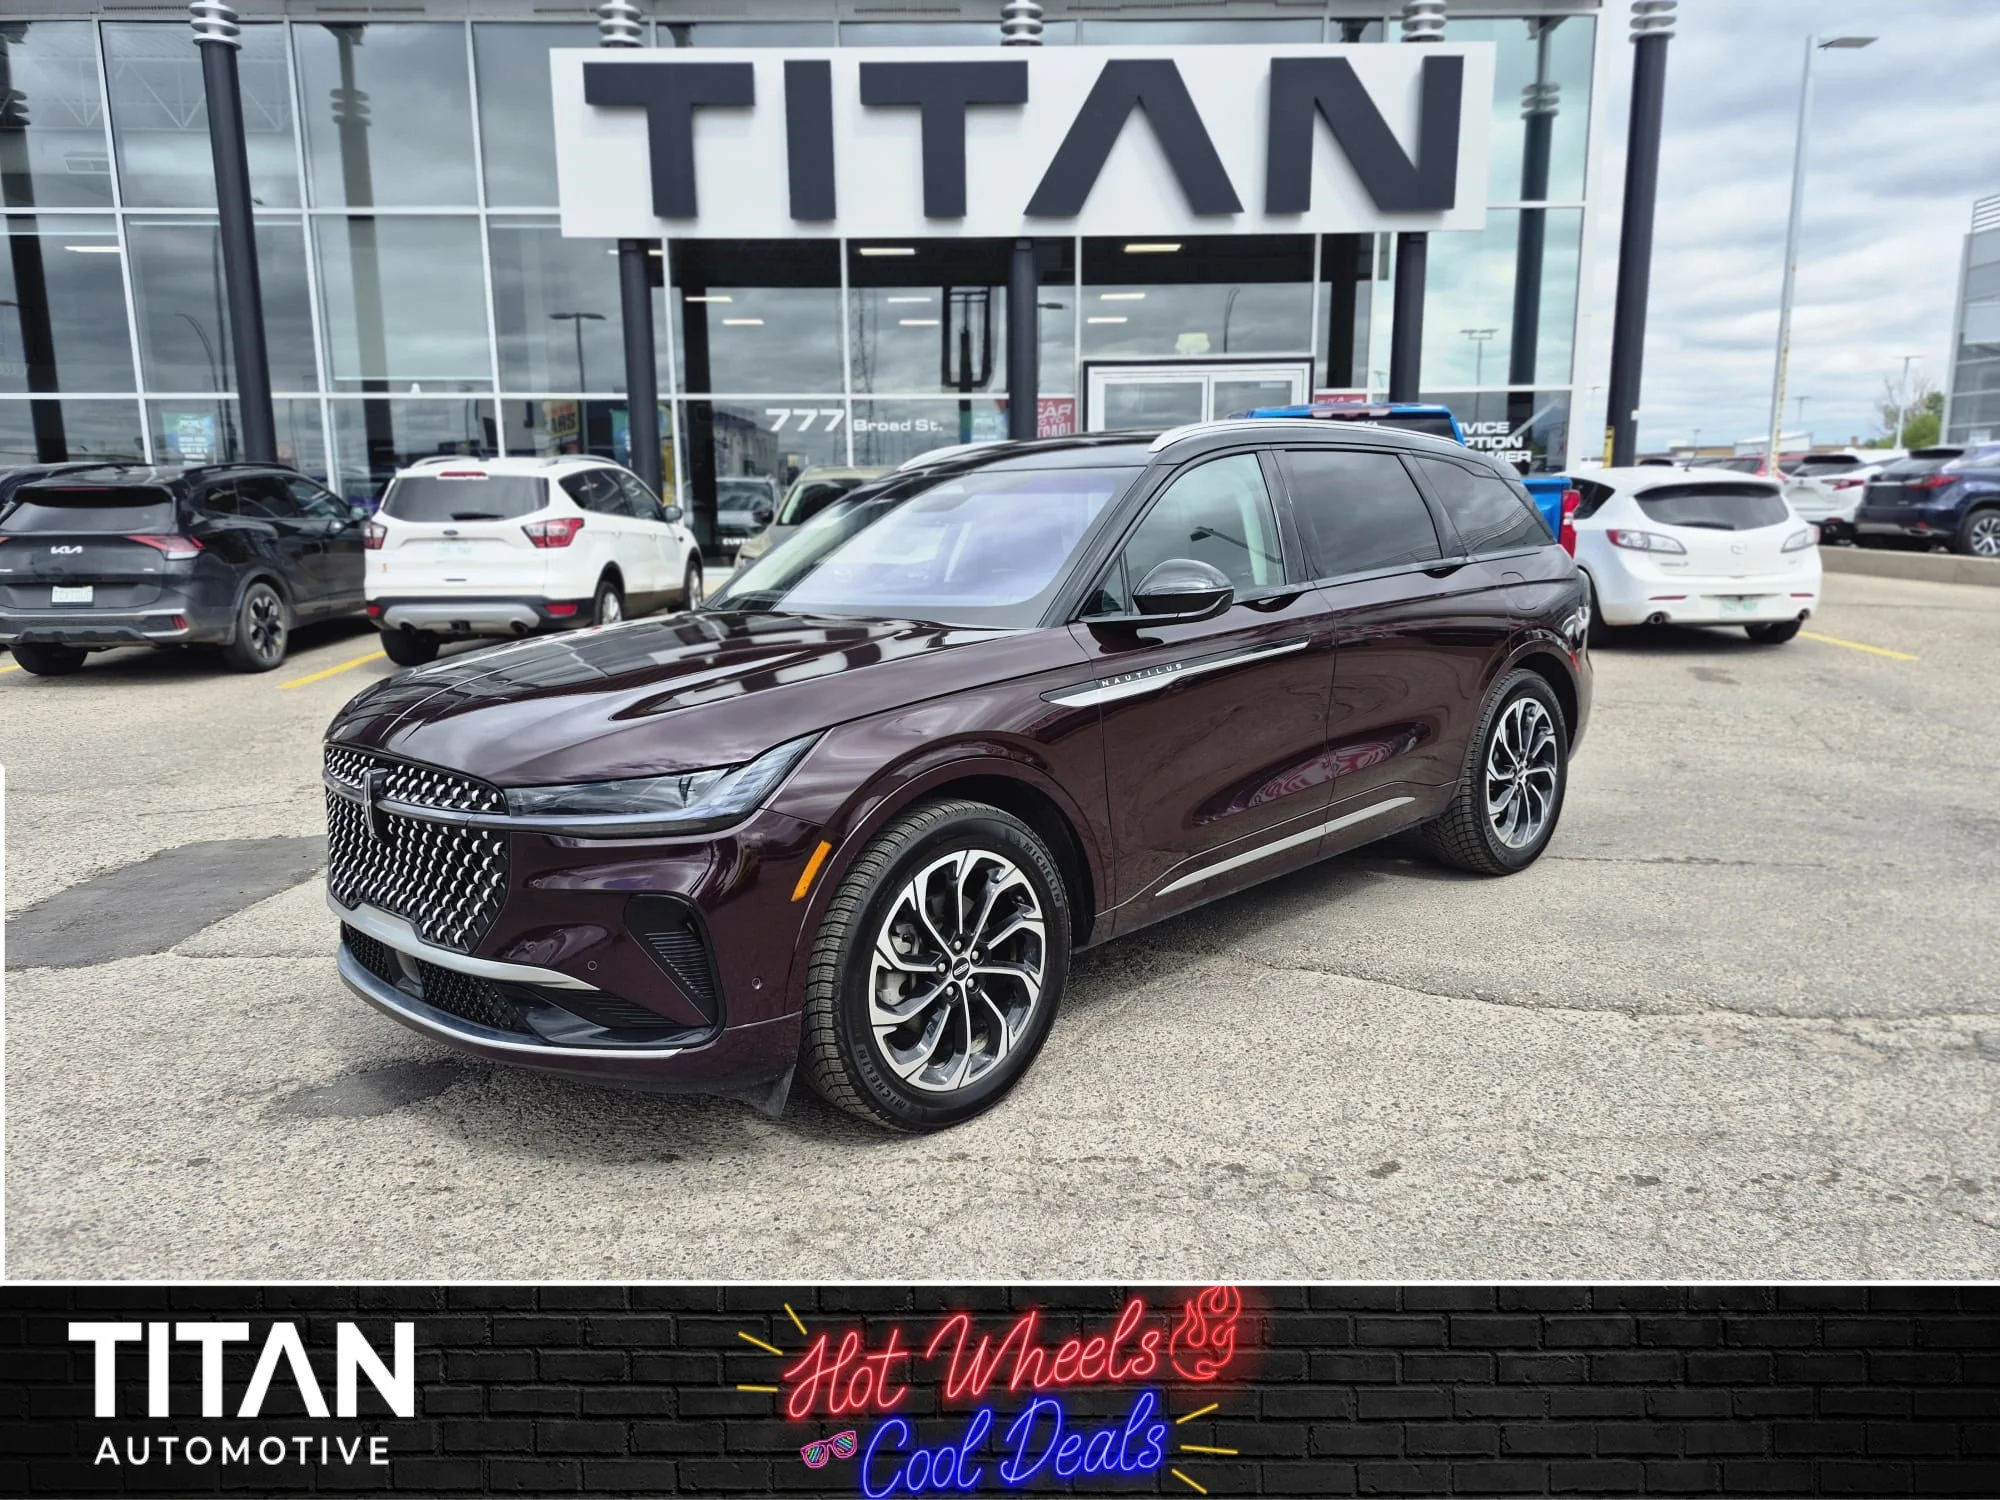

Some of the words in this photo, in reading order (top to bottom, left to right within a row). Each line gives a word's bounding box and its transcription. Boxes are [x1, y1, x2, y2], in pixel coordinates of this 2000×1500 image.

[583, 55, 1464, 220] TITAN
[765, 408, 845, 432] 777
[853, 419, 911, 432] Broad
[915, 419, 944, 432] St.
[1457, 421, 1510, 434] VICE
[50, 546, 83, 554] KIA
[1101, 663, 1183, 688] NAUTILUS
[1023, 842, 1061, 902] MICHELIN
[857, 1048, 907, 1110] MICHELIN
